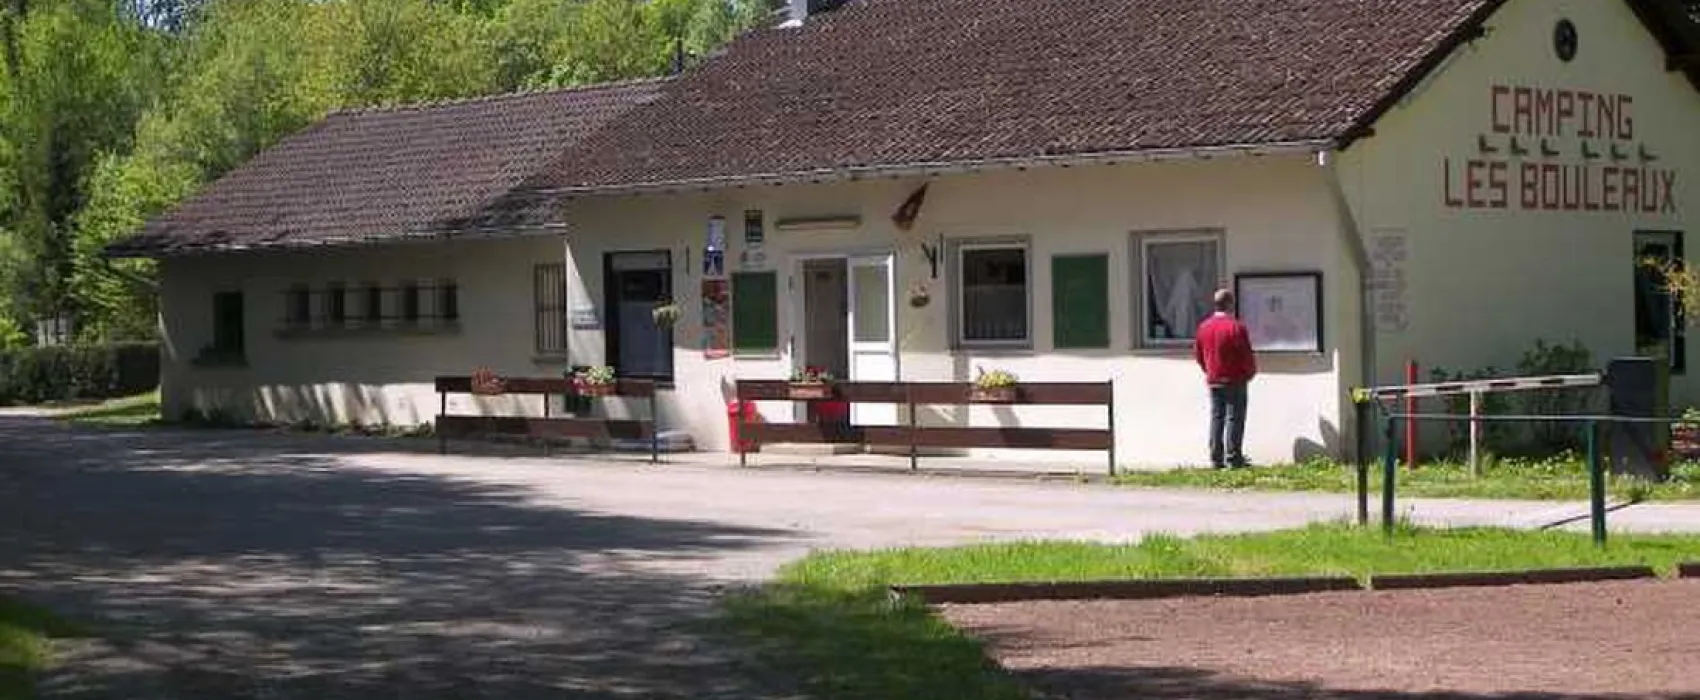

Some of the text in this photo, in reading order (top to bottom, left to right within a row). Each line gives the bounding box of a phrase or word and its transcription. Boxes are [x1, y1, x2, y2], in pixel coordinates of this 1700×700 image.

[1492, 85, 1633, 140] CAMPING
[1444, 158, 1676, 213] LES BOULEAUX
